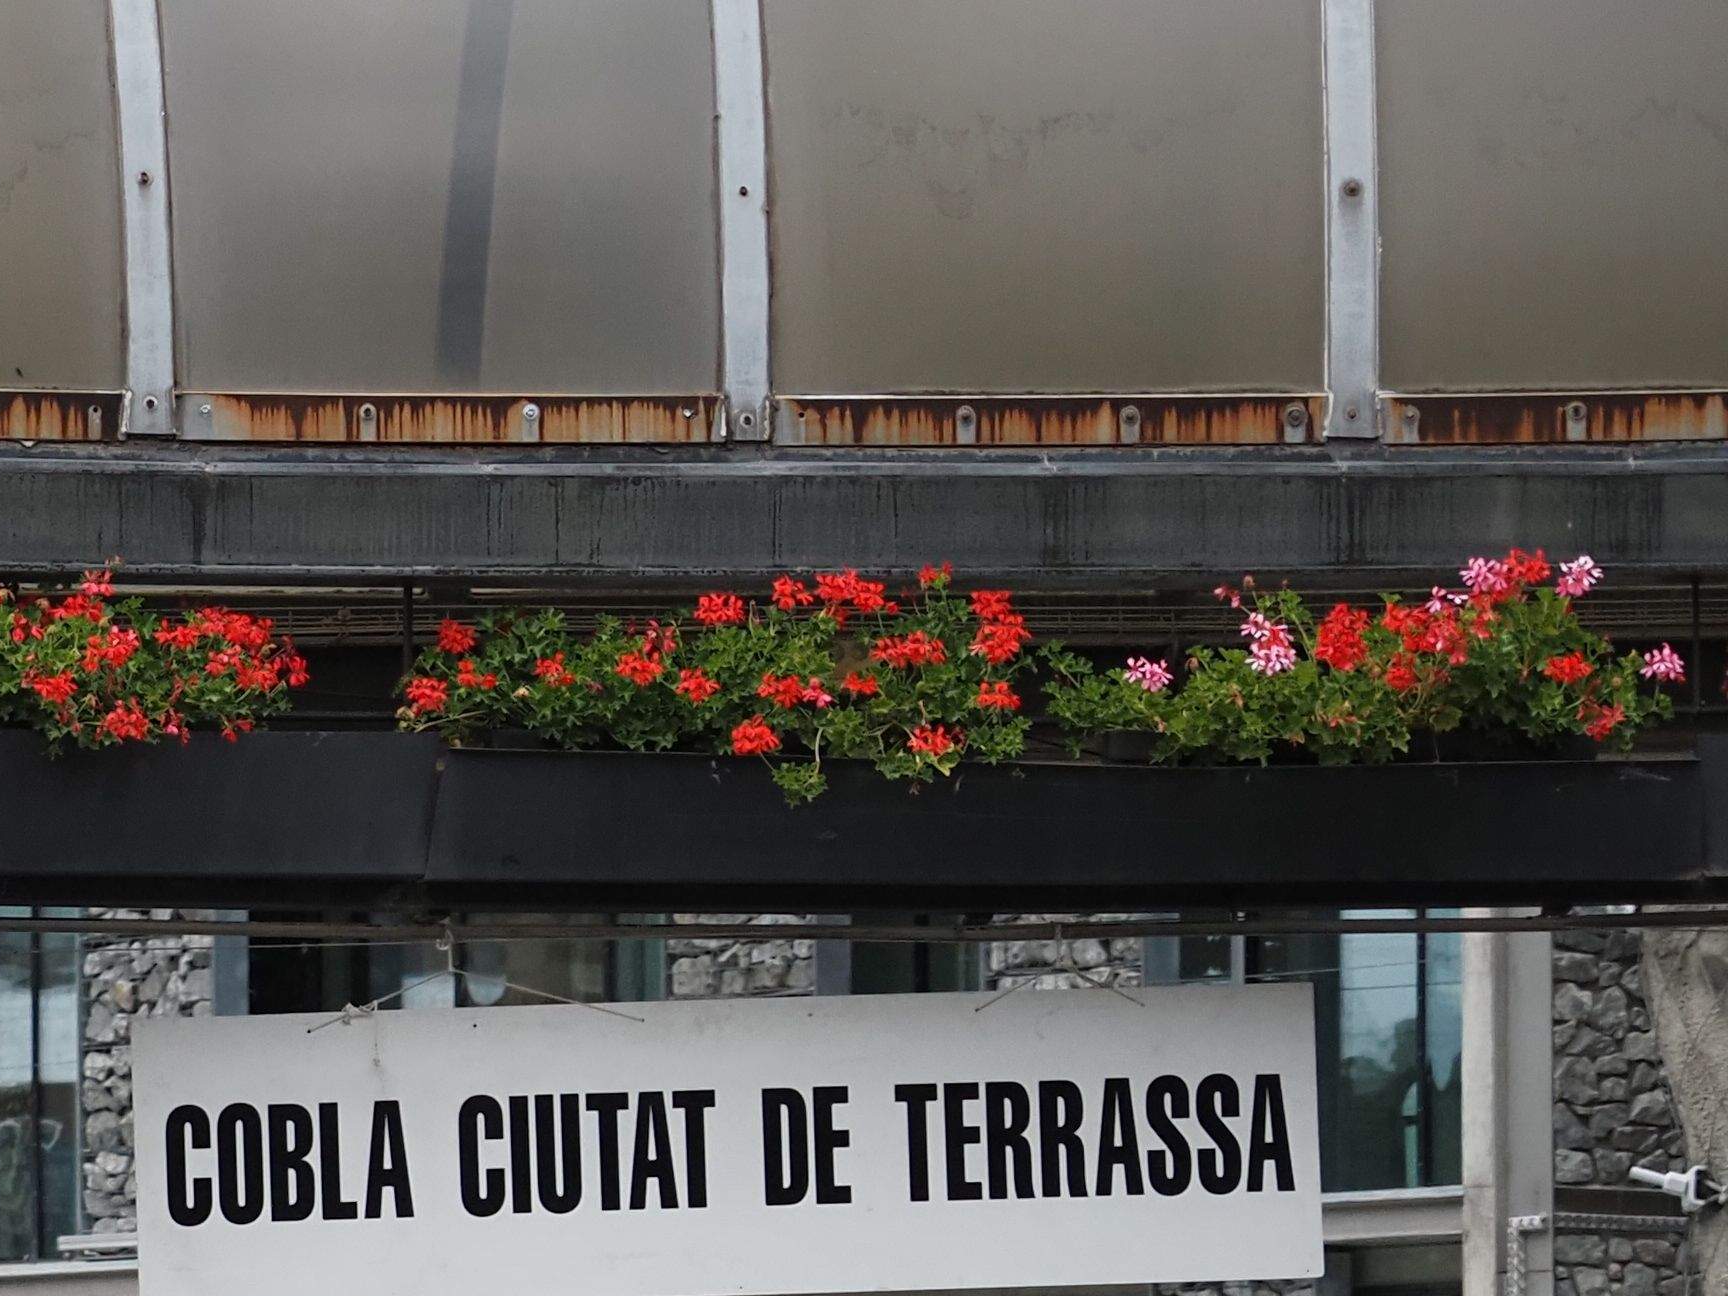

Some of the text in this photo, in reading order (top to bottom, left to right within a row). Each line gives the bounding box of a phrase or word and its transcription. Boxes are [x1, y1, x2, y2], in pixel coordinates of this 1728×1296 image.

[166, 1074, 1295, 1227] COBLA CIUTAT DE TERRASSA
